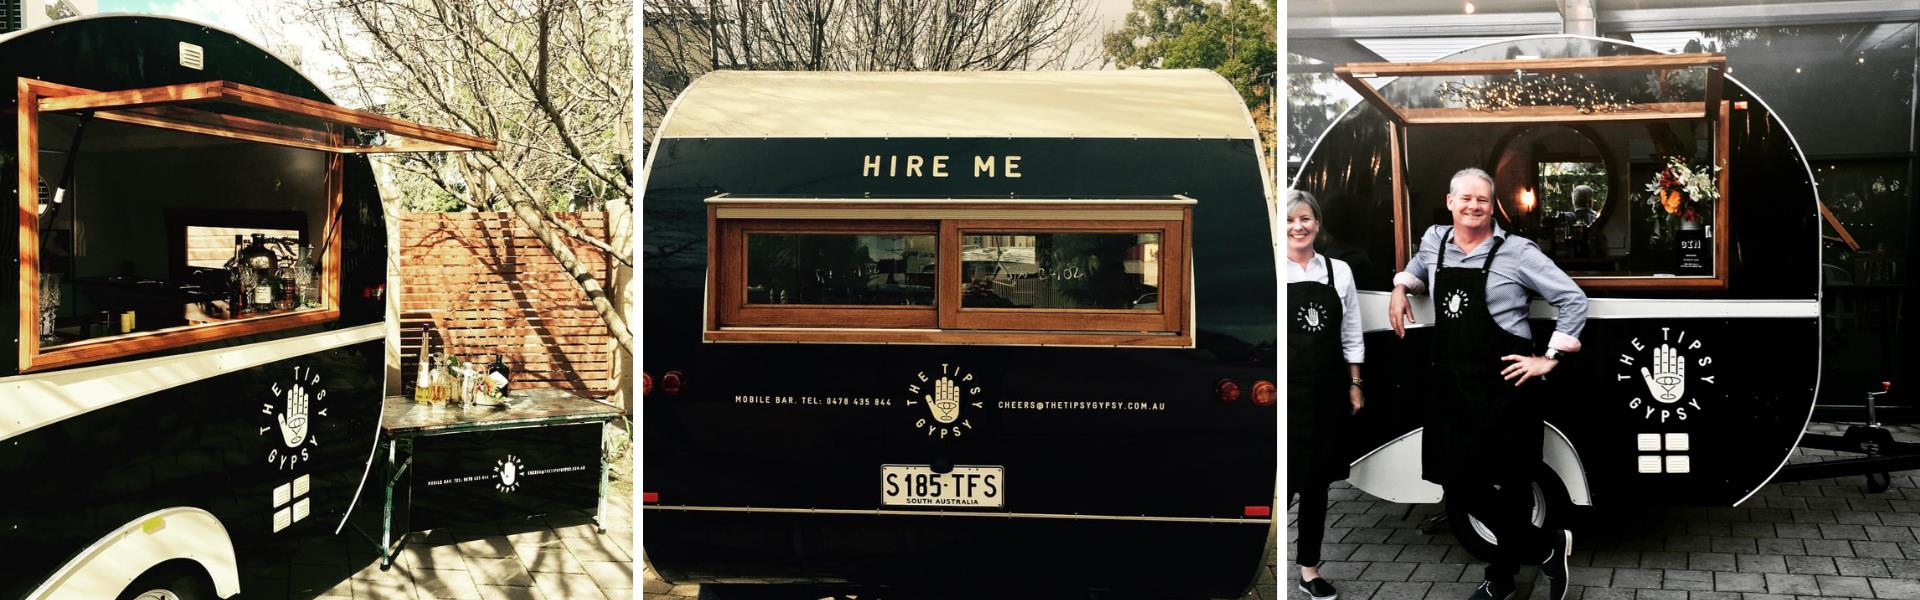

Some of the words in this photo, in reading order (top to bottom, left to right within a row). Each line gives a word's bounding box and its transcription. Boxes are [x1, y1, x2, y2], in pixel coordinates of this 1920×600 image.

[863, 155, 949, 177] HIRE
[974, 155, 1022, 178] ME
[1617, 337, 1645, 381] THE
[1661, 327, 1715, 384] TIPSY
[906, 371, 929, 407] THE
[941, 363, 983, 409] TIPSY
[260, 382, 282, 436] THE
[294, 366, 328, 416] TIPSY
[735, 395, 771, 404] MOBILE
[775, 396, 798, 404] BAR.
[802, 396, 823, 405] TEL:
[826, 397, 849, 405] 0478
[853, 397, 870, 406] 435
[874, 398, 891, 406] 844
[998, 401, 1165, 410] CHEERS@THETIPSYGYPSY.COM.AU
[1629, 398, 1701, 423] GYPSY
[915, 418, 972, 439] GYPSY
[268, 435, 318, 470] GYPSY
